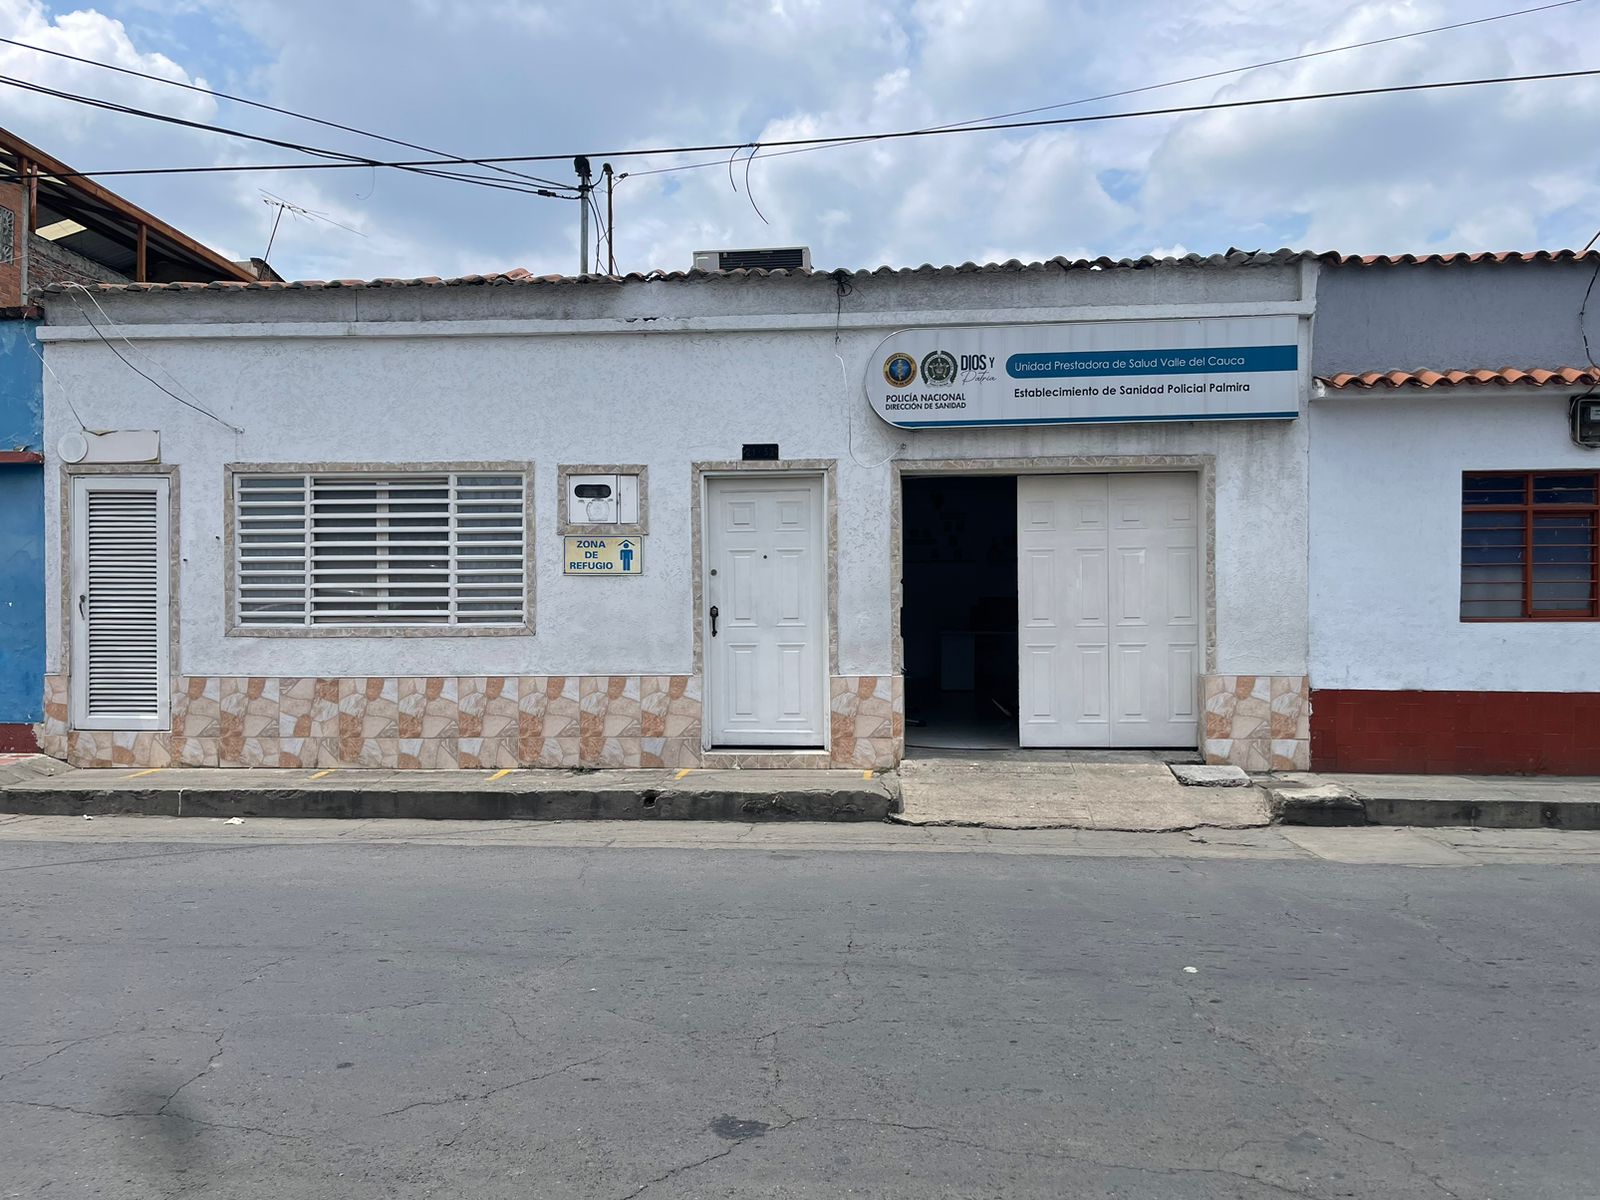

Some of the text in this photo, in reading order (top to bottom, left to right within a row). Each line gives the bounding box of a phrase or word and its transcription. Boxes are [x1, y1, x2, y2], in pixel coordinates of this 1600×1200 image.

[960, 355, 995, 370] DIOS Y
[1014, 356, 1245, 372] Unidad Prestadora de Salud Valle del Cauca
[961, 370, 997, 385] Patria
[1014, 382, 1250, 398] Establecimiento de Sanidad Policial Palmira
[885, 392, 966, 403] POLICÍA NACIONAL
[885, 401, 967, 411] DIRECCIÓN DE SANIDAD
[576, 540, 606, 549] ZONA
[584, 551, 599, 559] DE
[569, 561, 614, 570] REFUGIO
